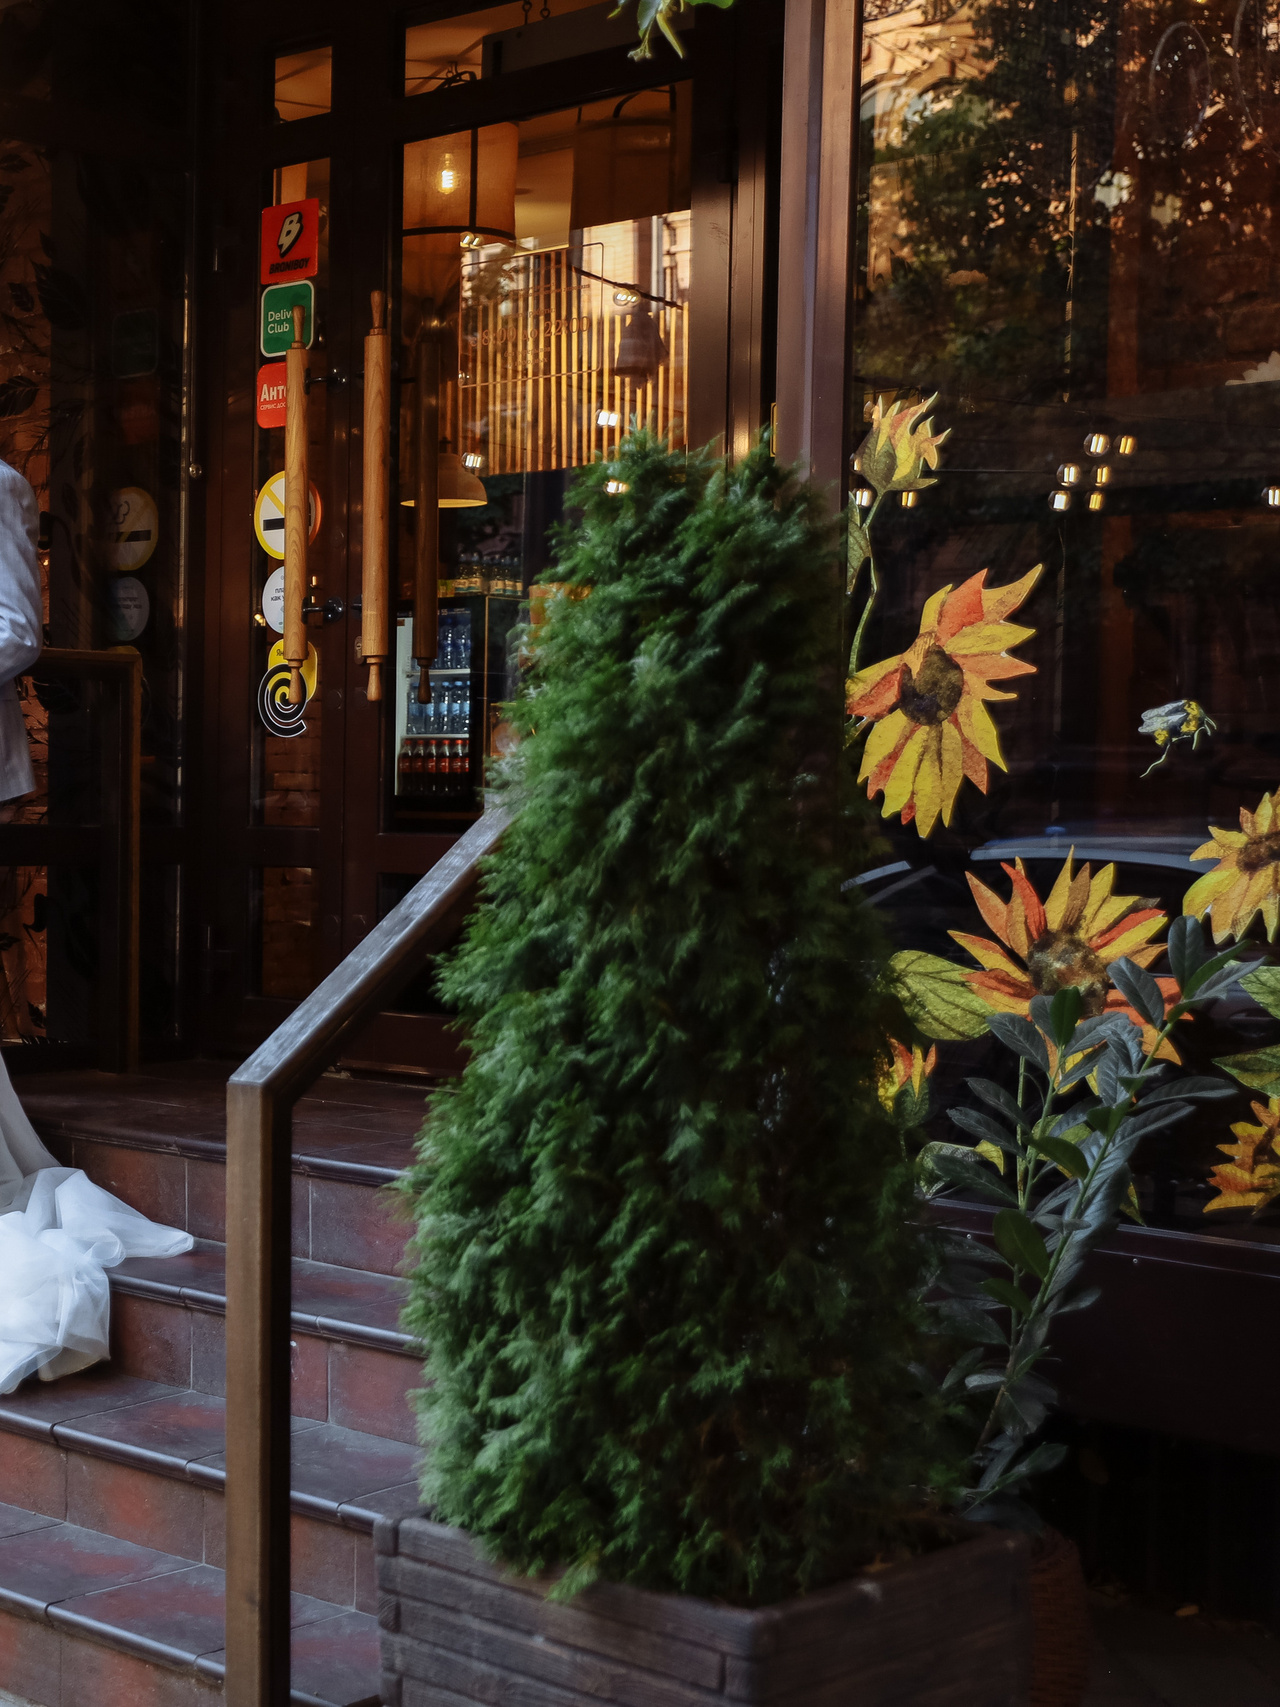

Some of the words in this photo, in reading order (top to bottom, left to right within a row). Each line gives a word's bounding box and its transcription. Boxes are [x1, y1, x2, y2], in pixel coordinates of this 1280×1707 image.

[269, 257, 310, 274] BRONIBOY
[268, 308, 293, 322] Deliv
[267, 322, 290, 334] Club
[544, 316, 590, 338] 22:00
